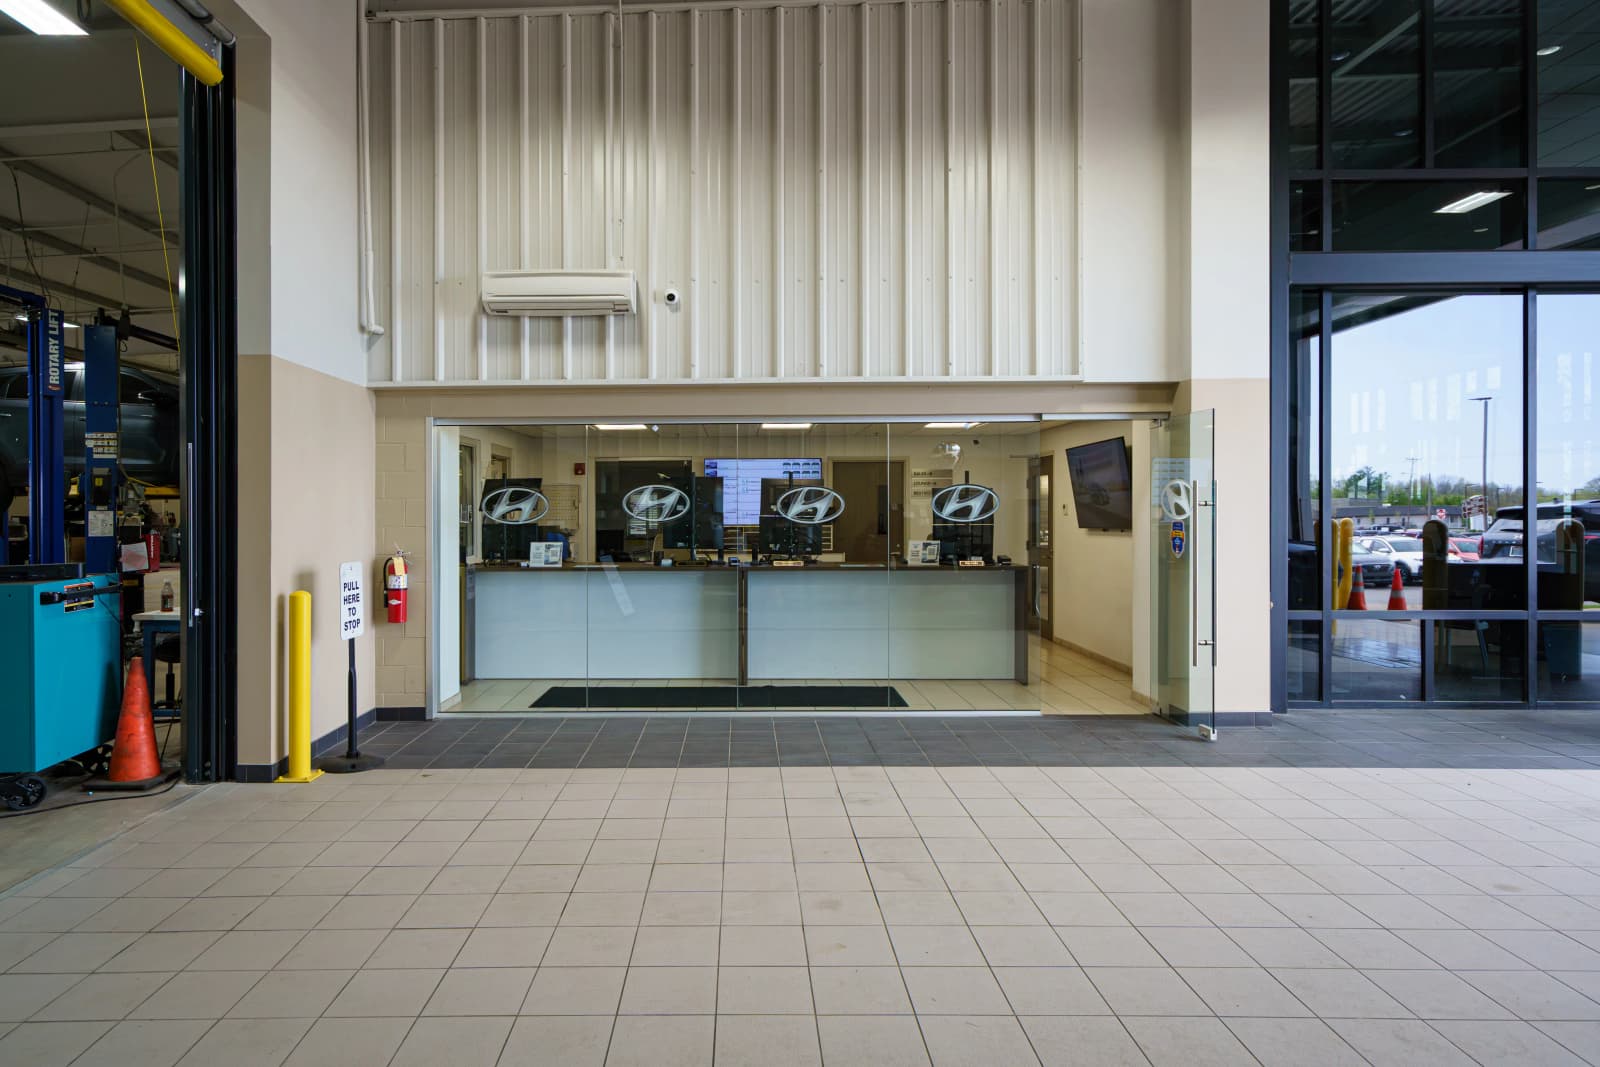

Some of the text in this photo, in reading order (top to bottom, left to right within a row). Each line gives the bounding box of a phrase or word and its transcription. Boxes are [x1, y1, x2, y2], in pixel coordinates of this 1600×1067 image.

[48, 310, 60, 384] ROTARY LIFT
[343, 580, 360, 592] PULL
[343, 593, 360, 605] HERE
[347, 607, 357, 617] TO
[343, 618, 361, 631] STOP
